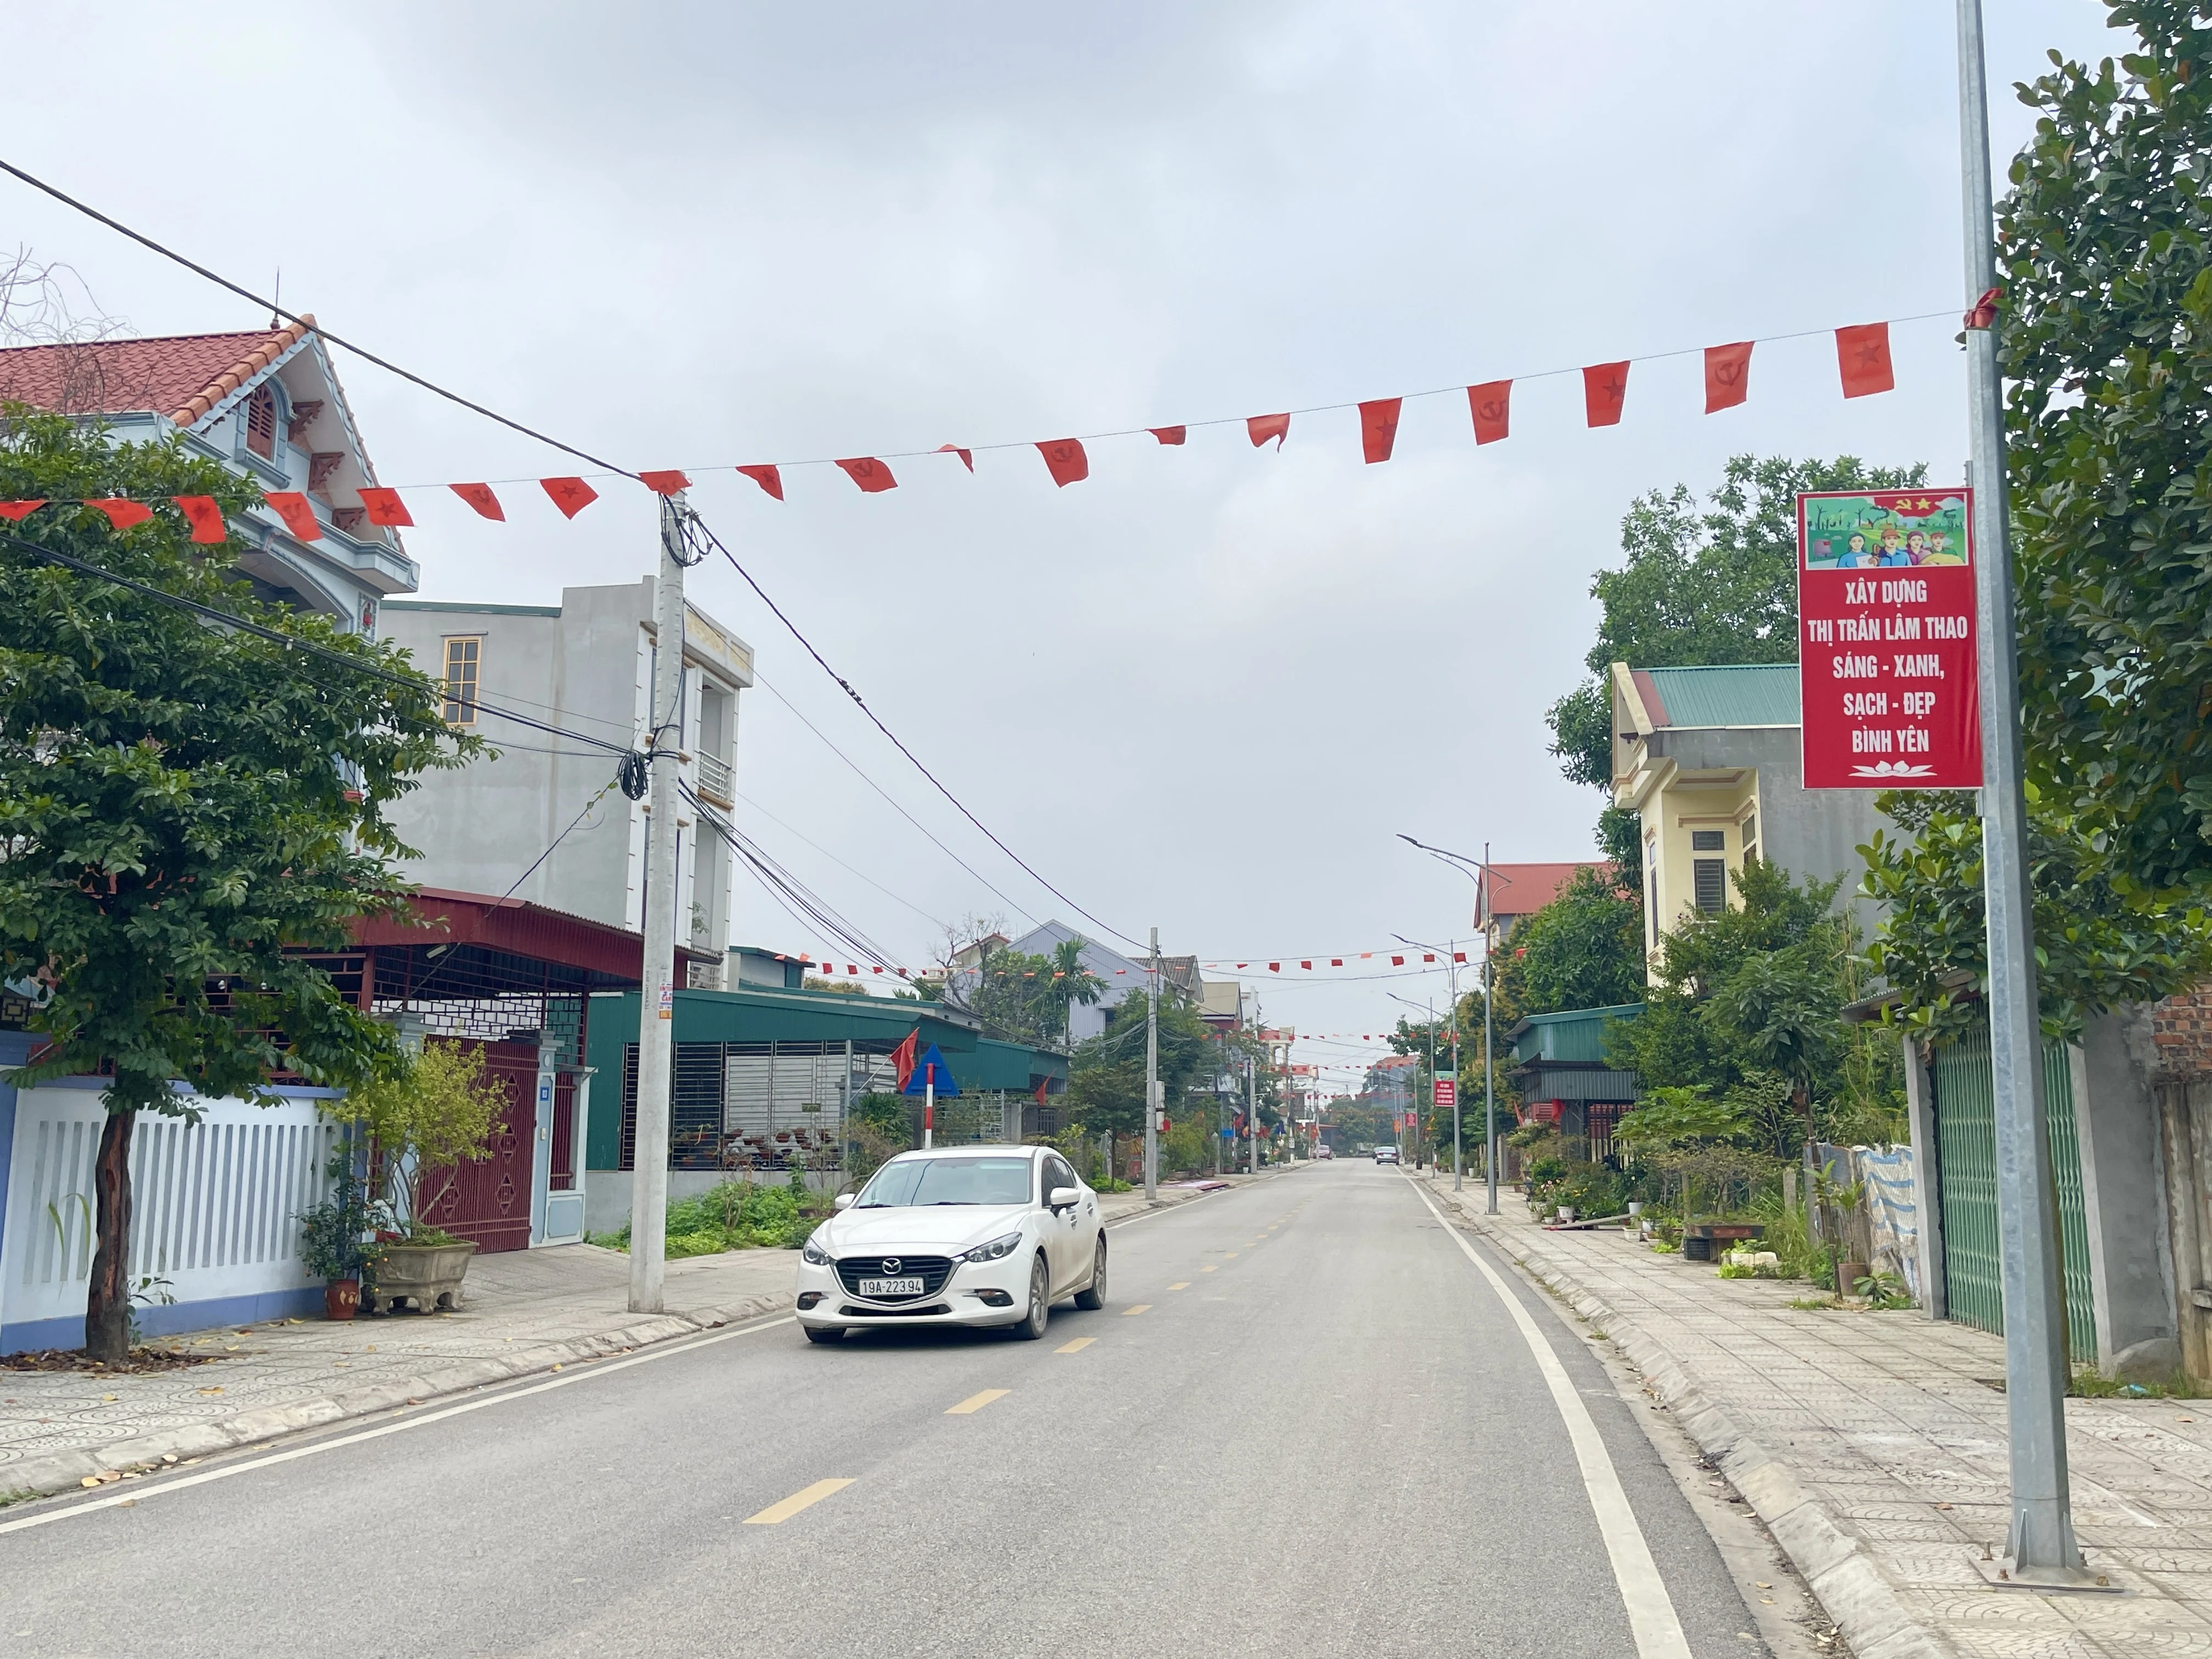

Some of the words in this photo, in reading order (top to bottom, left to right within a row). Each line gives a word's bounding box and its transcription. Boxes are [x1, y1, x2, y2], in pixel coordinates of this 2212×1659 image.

[1845, 577, 1877, 605] XÂY
[1882, 578, 1928, 608] DỰNG
[1807, 619, 1833, 647] THỊ
[1837, 610, 1881, 642] TRẤN
[1885, 612, 1921, 641] LÂM
[1925, 616, 1968, 640] THAO
[1832, 651, 1878, 679] SÁNG
[1893, 654, 1945, 680] XANH,
[1843, 692, 1887, 721] SẠCH
[1903, 691, 1936, 720] ĐẸP
[1852, 725, 1892, 753] BÌNH
[1896, 724, 1929, 753] YÊN
[863, 1280, 922, 1294] 19A-223.94
